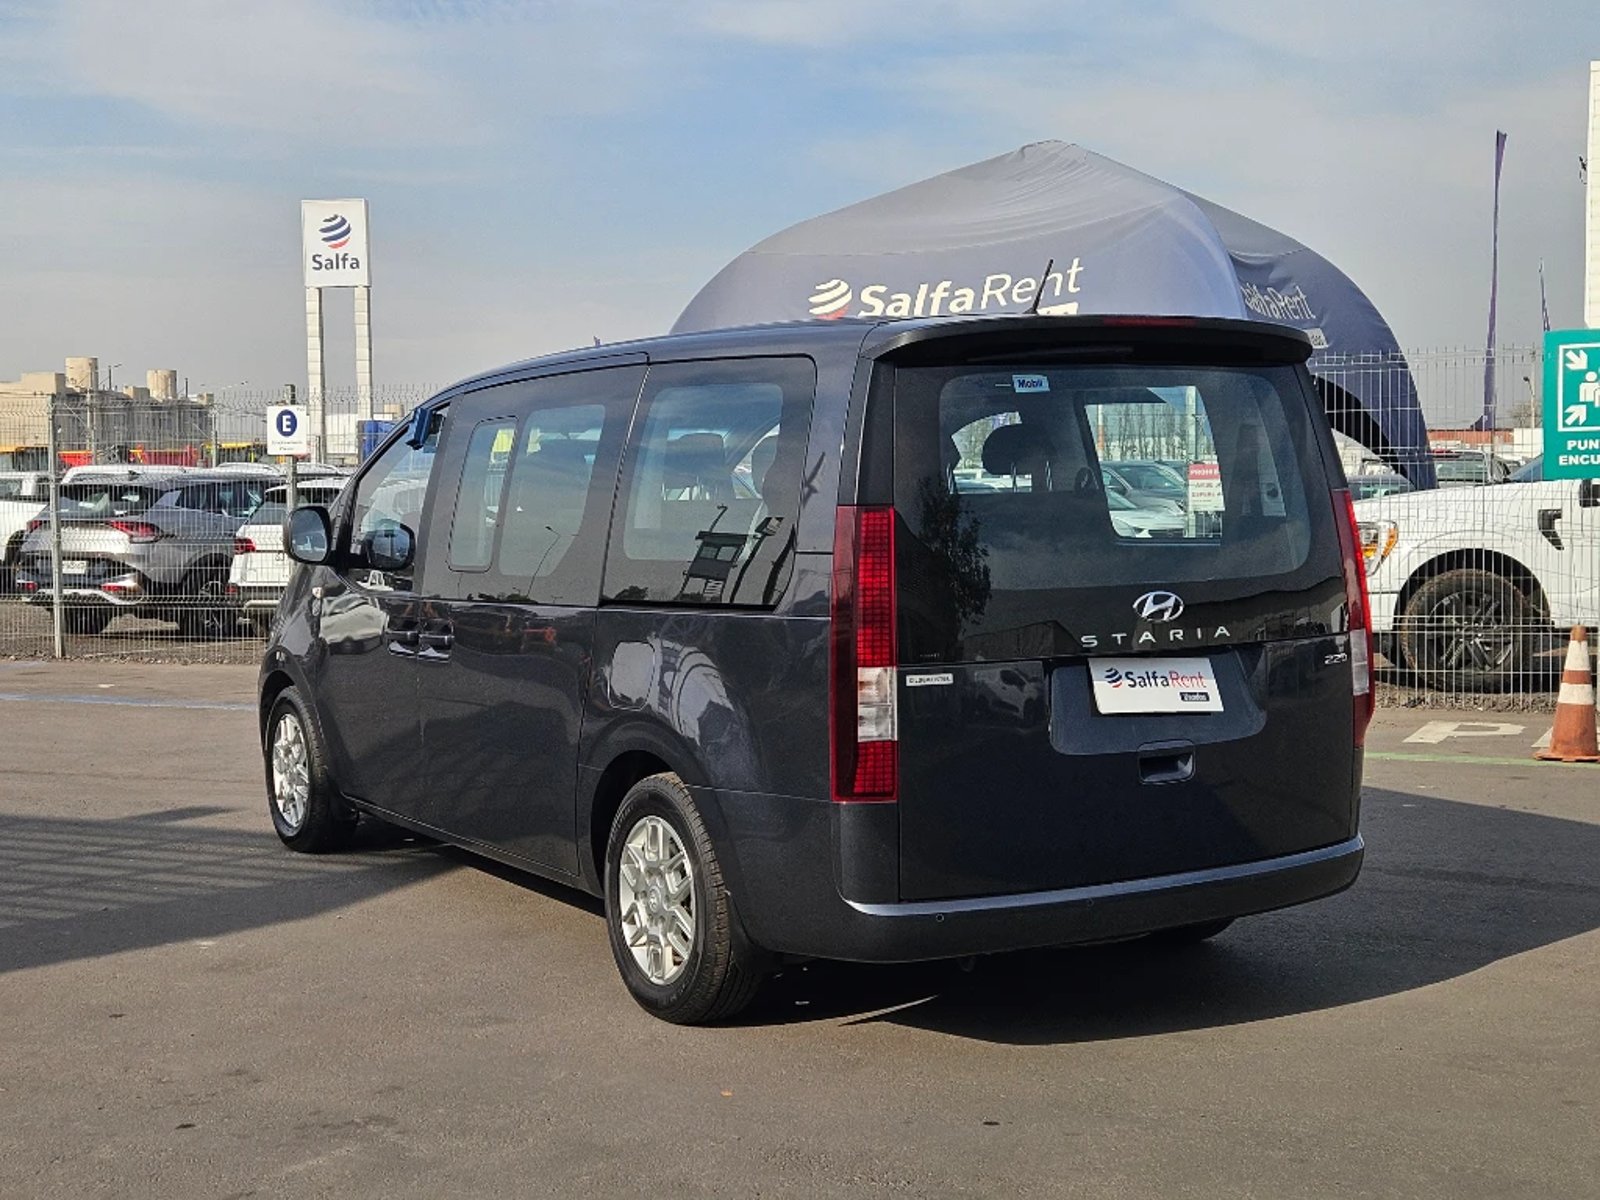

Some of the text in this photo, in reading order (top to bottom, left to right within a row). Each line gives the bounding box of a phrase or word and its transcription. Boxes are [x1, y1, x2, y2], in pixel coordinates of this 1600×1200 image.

[312, 252, 360, 271] Salfa
[858, 257, 1084, 317] SalfaRent
[282, 415, 292, 432] E
[1567, 439, 1599, 450] PUN
[1559, 454, 1600, 466] ENCU
[1080, 626, 1231, 648] STARIA
[1124, 670, 1207, 688] SalfaRent
